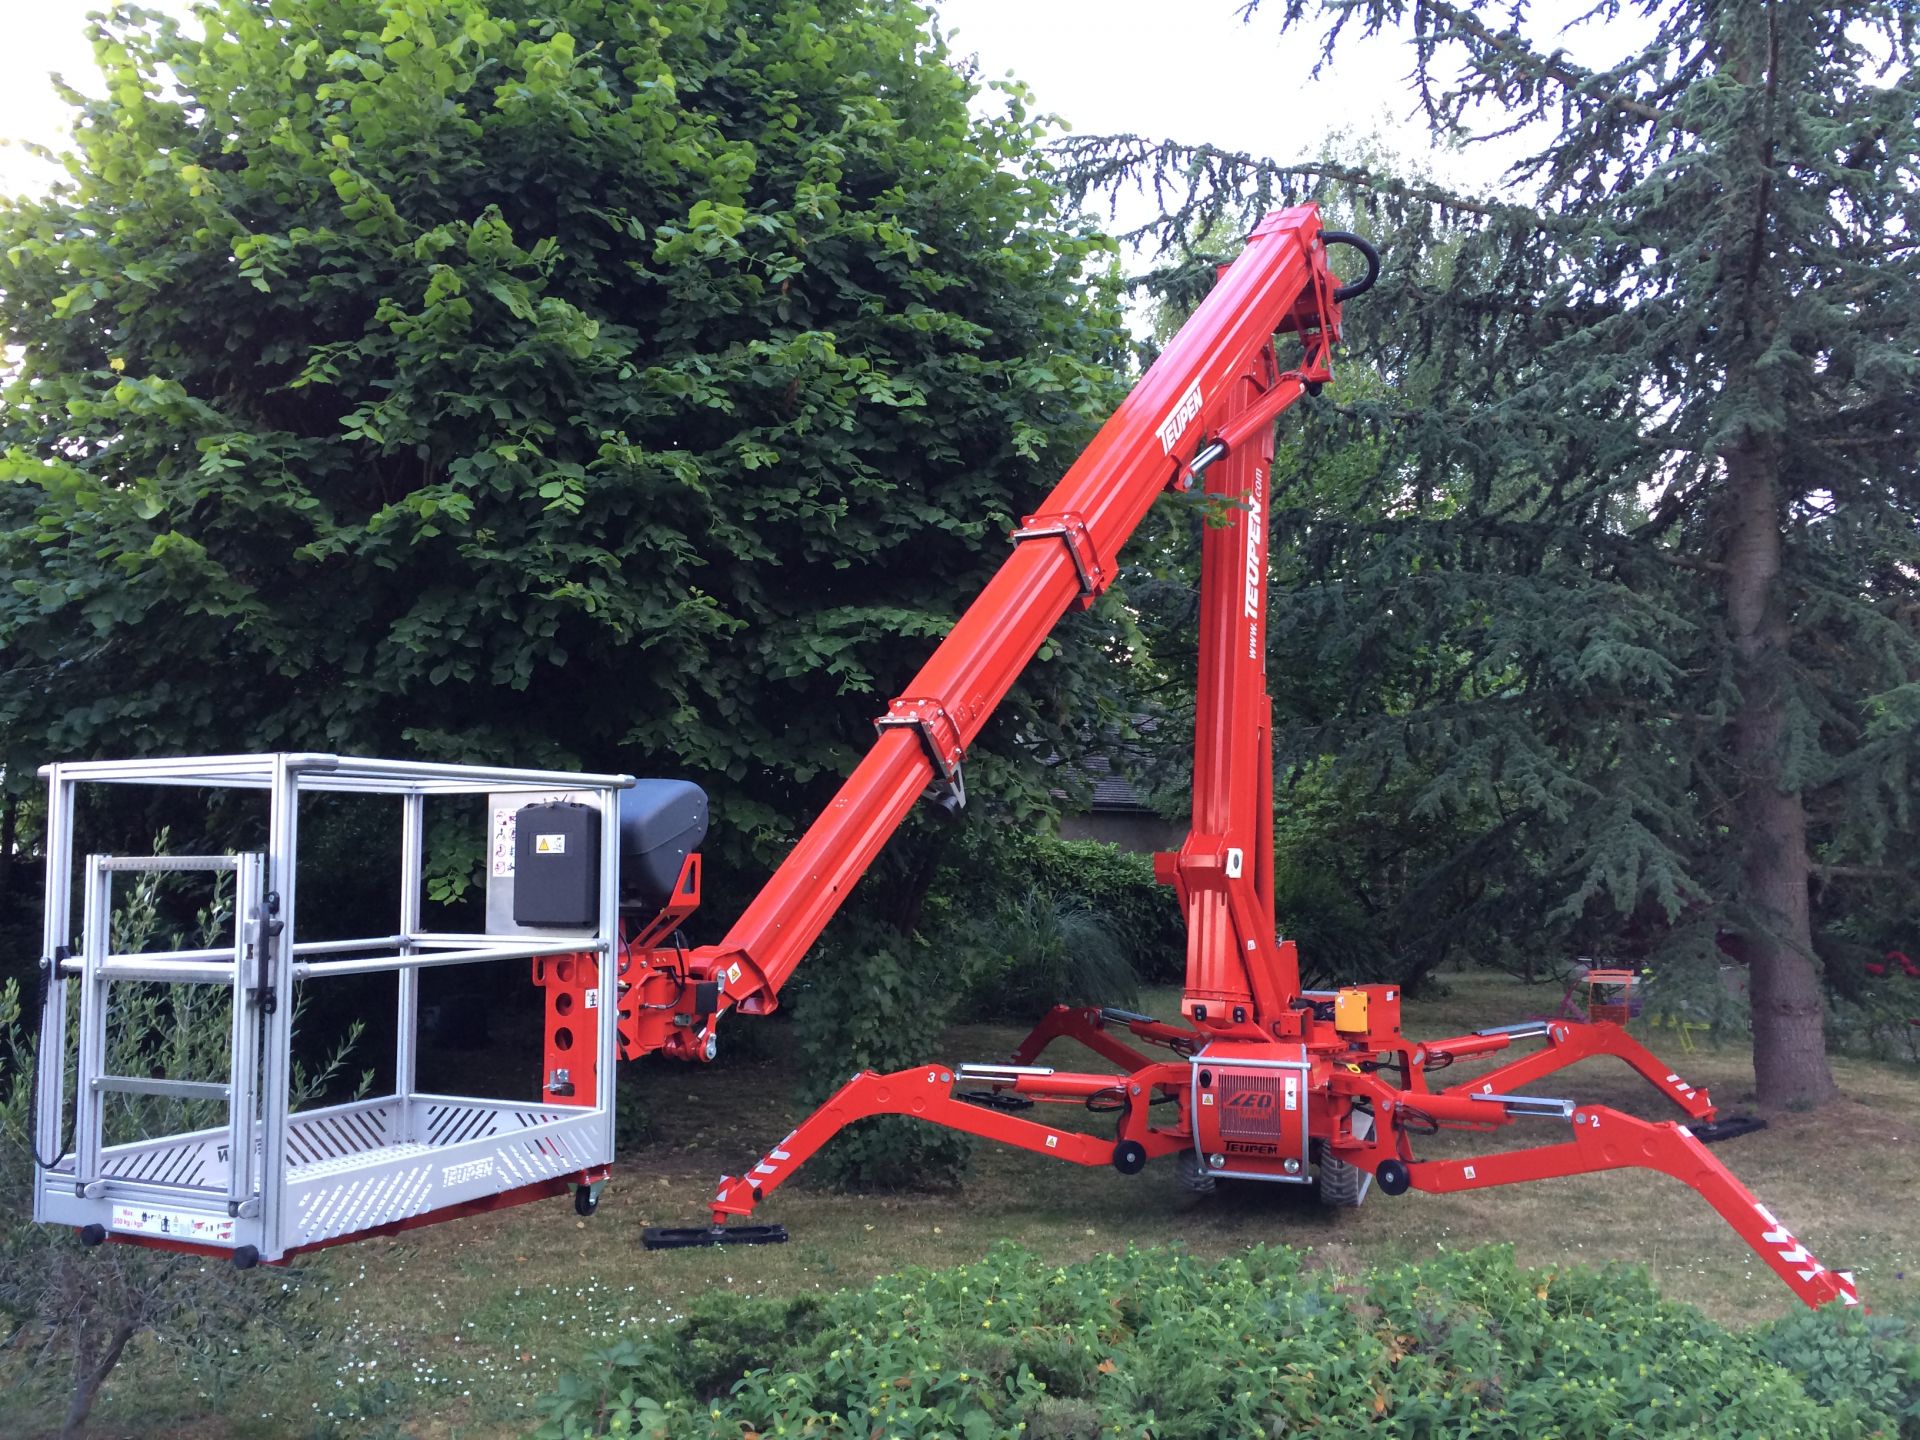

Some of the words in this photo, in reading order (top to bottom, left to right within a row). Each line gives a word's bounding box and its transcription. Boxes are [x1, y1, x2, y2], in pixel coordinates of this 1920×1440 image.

[1155, 376, 1203, 457] TEUPEN
[928, 1072, 936, 1083] 3
[1591, 1115, 1601, 1128] 2
[442, 1156, 494, 1188] TEUPEN
